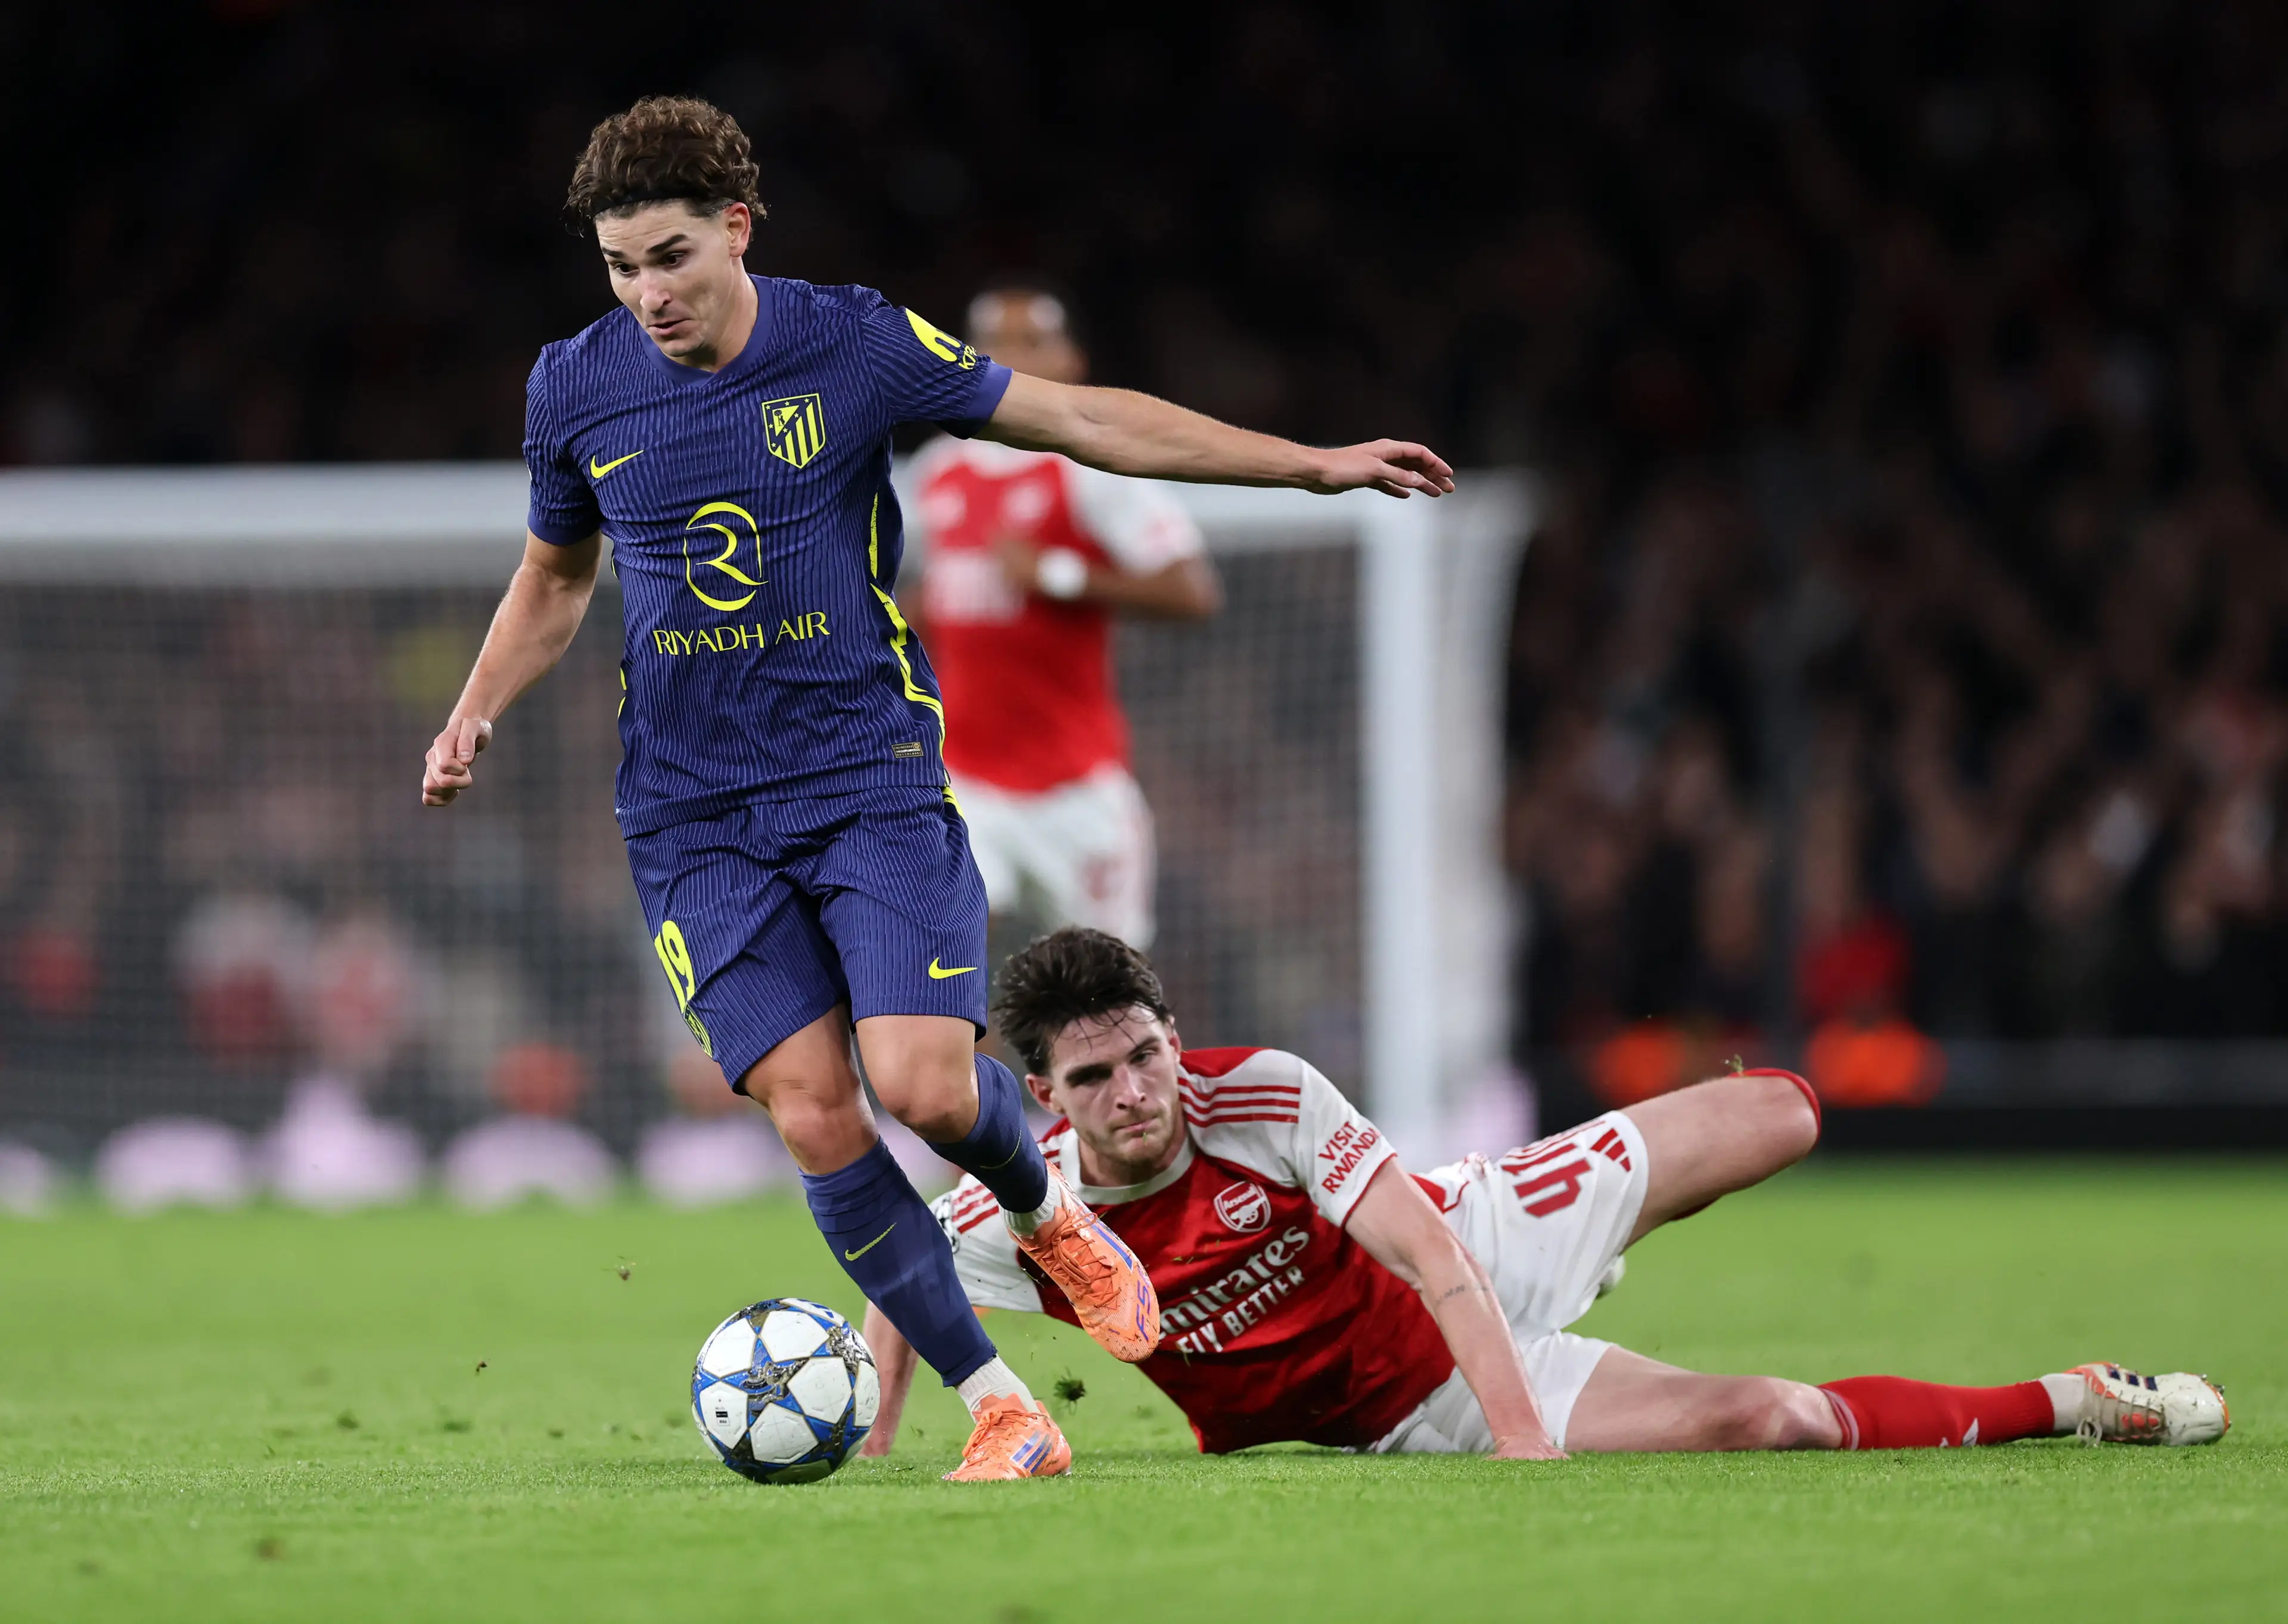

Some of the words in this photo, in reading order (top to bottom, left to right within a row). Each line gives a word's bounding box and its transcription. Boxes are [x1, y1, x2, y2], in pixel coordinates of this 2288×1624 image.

[653, 623, 764, 655] RIYADH
[775, 611, 831, 645] AIR
[654, 920, 696, 1014] 19
[1318, 1121, 1358, 1161] VISIT
[1158, 1226, 1310, 1340] mirates
[1223, 1265, 1305, 1336] BETTER
